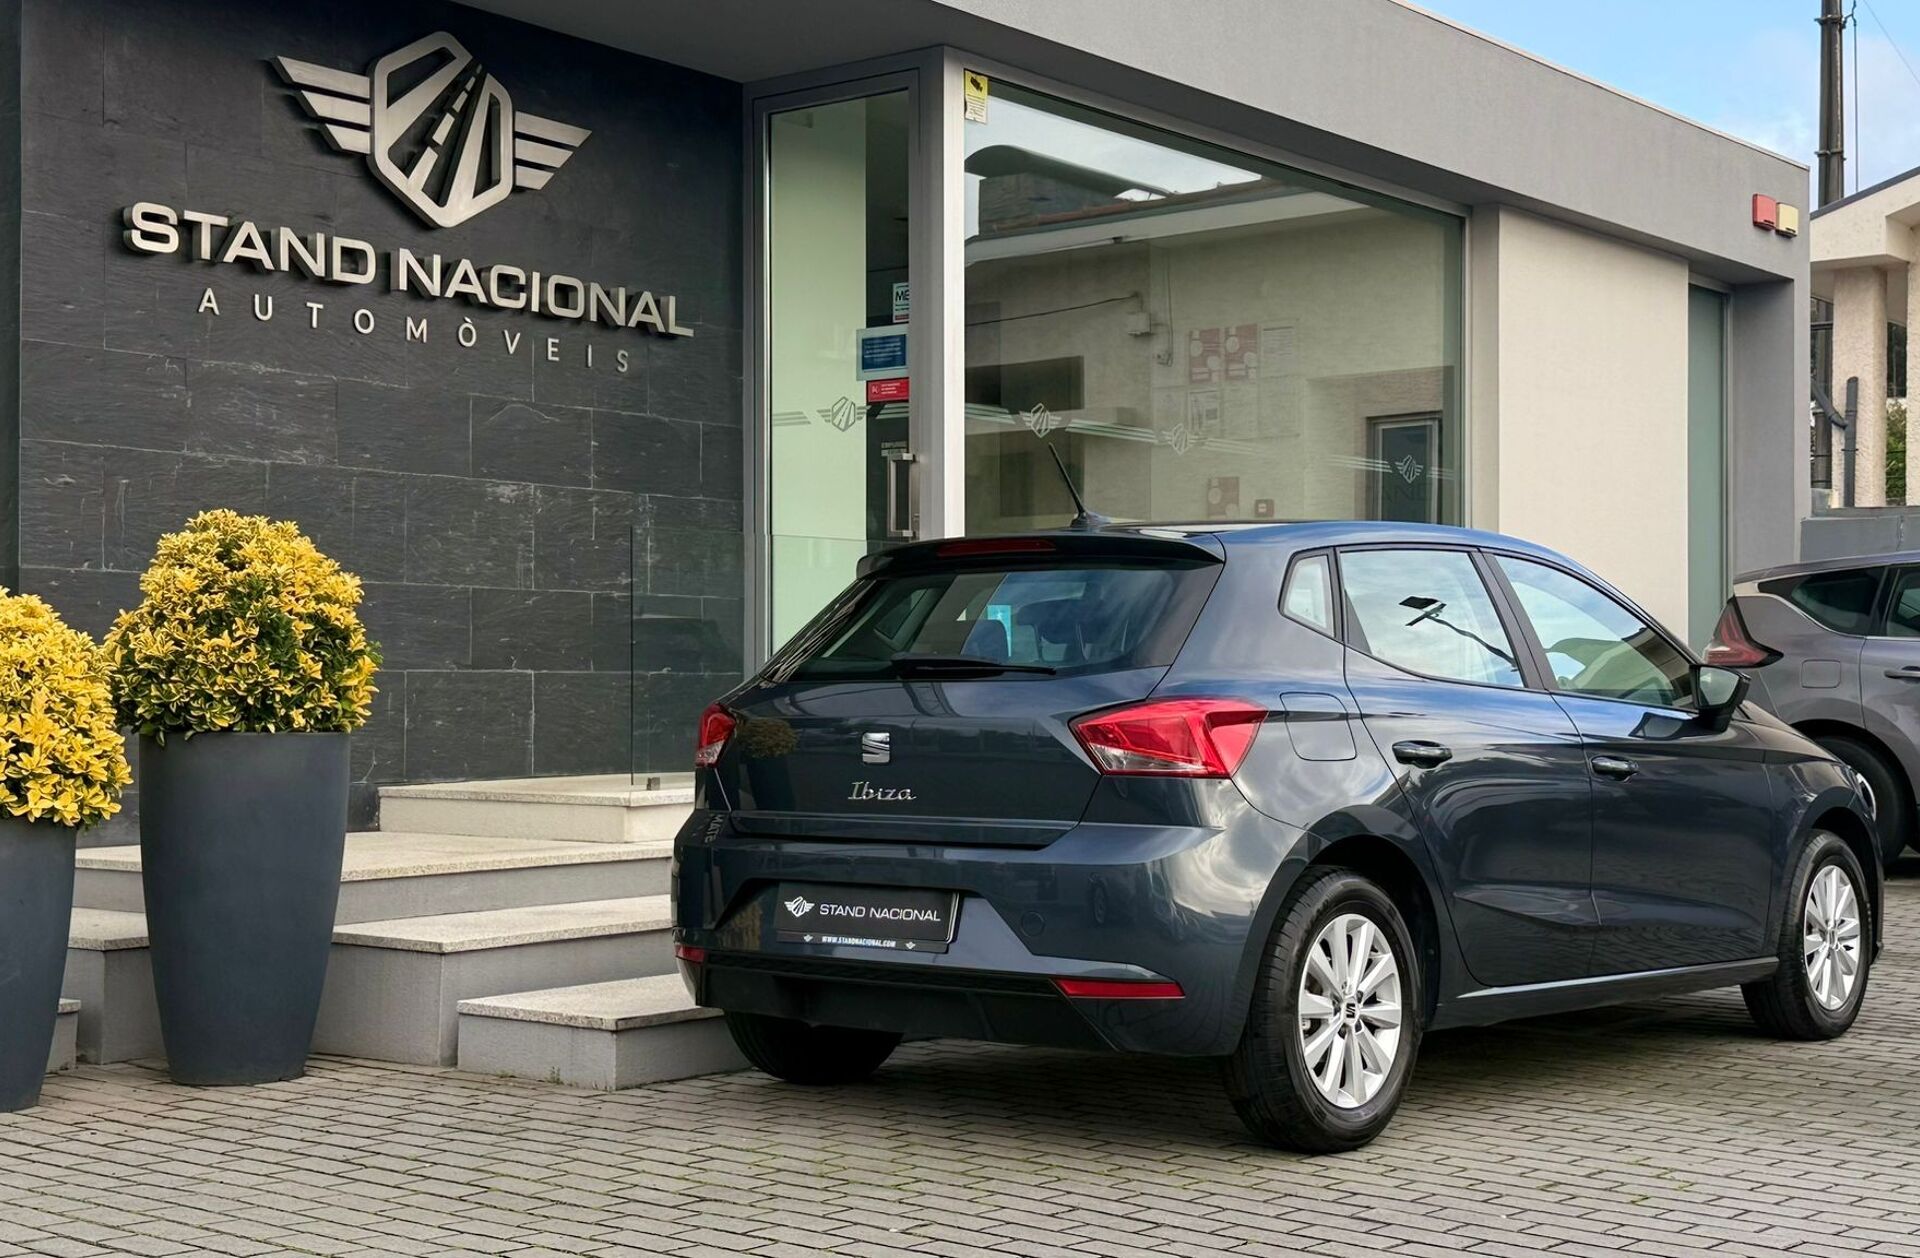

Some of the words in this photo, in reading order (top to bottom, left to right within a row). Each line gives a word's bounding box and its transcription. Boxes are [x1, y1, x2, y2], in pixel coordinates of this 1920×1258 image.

[125, 202, 377, 285] STAND
[391, 248, 695, 337] NACIONAL
[848, 781, 917, 801] Ibiza
[819, 903, 866, 918] STAND
[869, 906, 941, 922] NACIONAL
